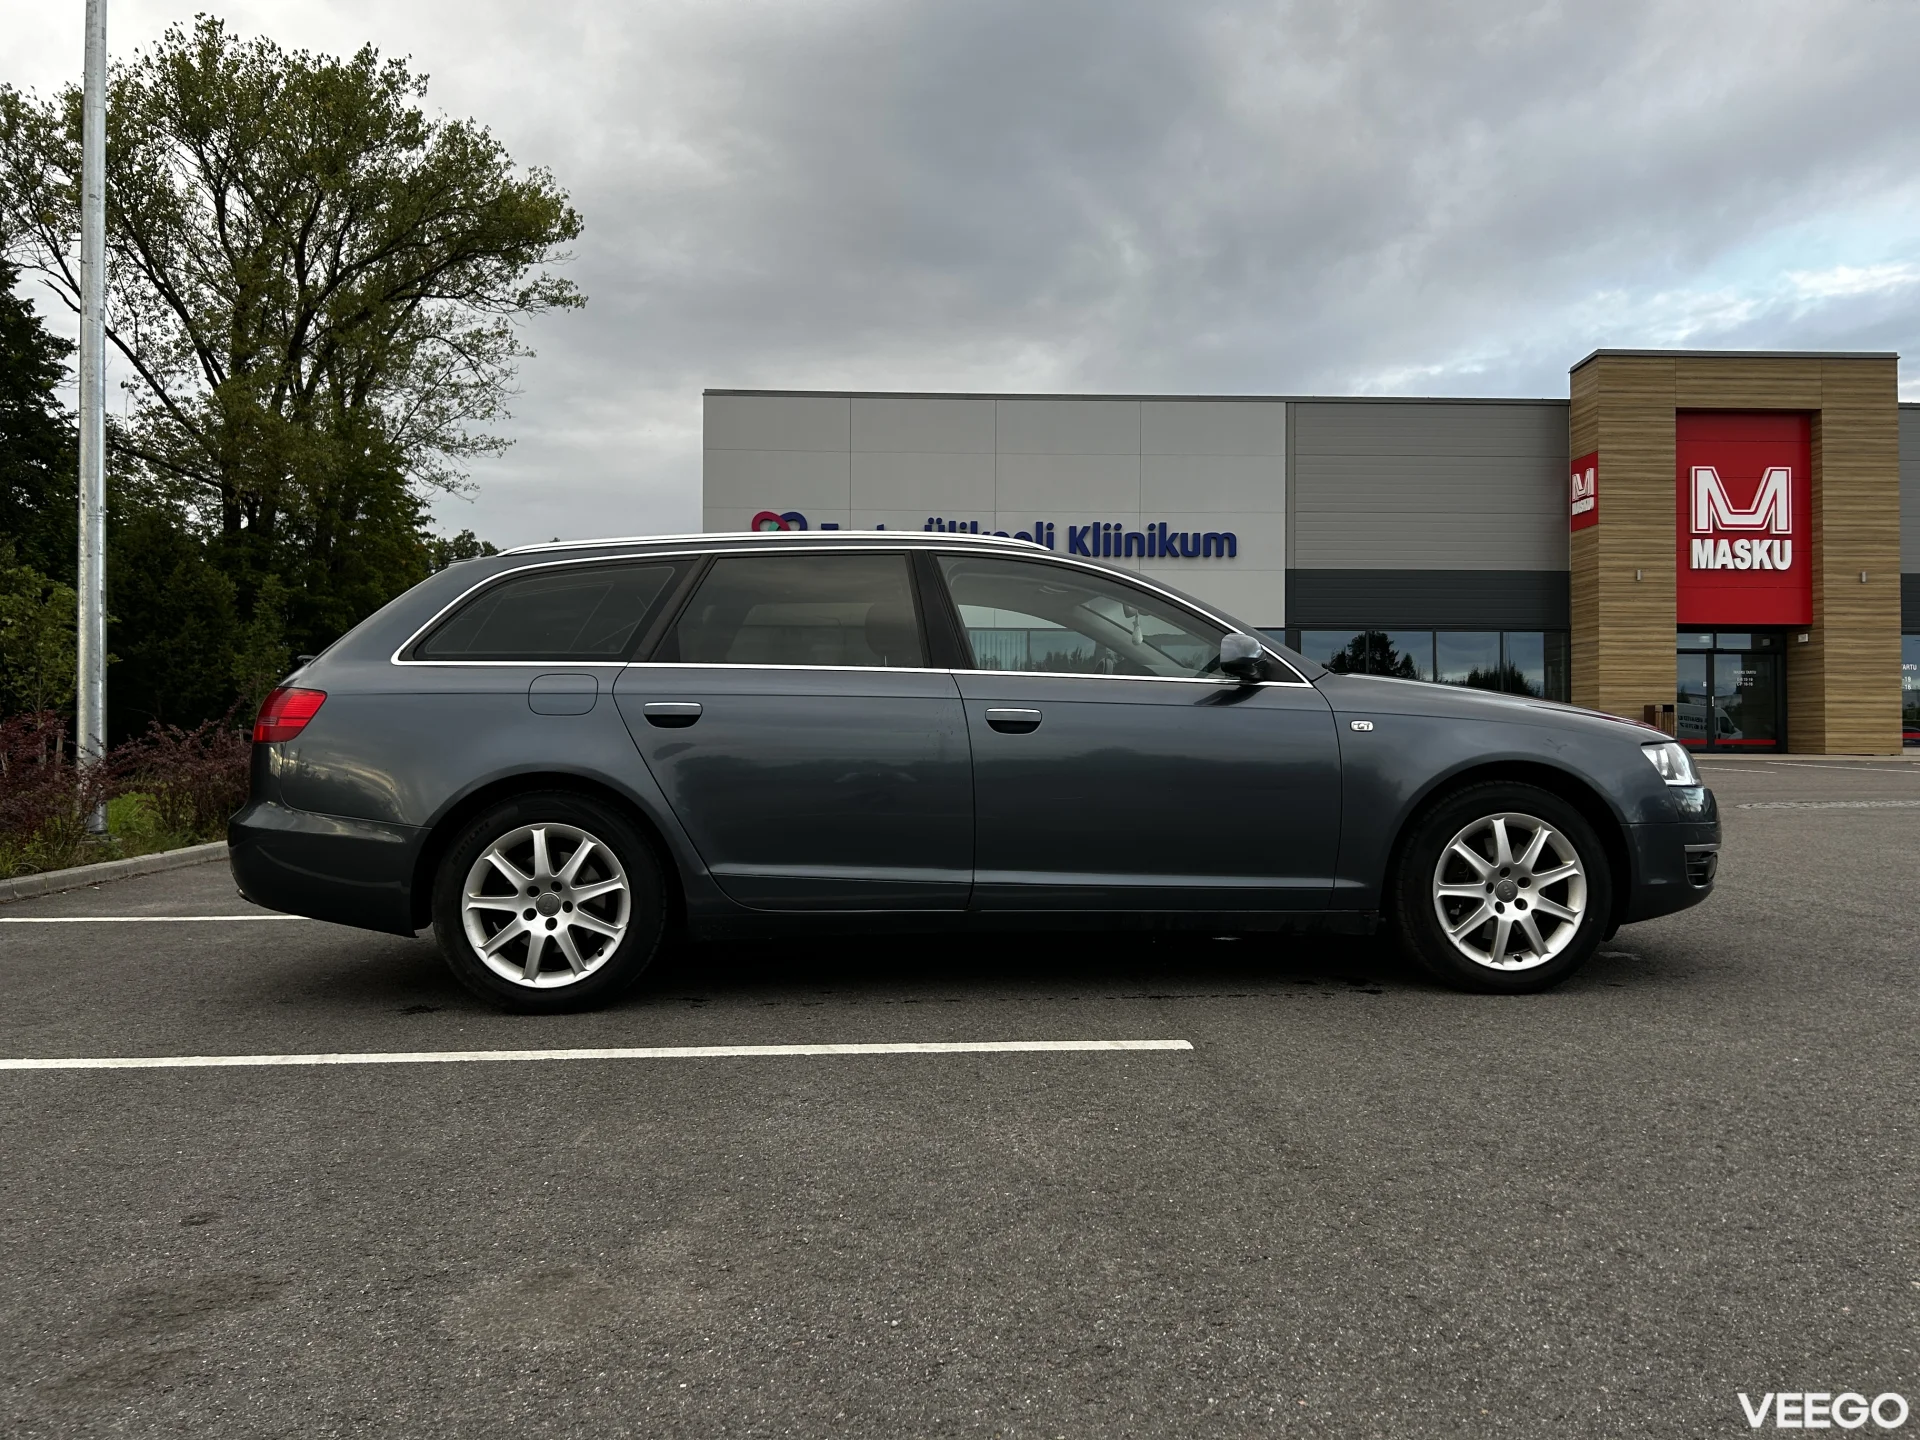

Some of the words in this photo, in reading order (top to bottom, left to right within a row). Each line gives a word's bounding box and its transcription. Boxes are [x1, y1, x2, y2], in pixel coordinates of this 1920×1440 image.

[1068, 521, 1237, 558] Kliinikum
[1690, 538, 1793, 571] MASKU
[1901, 663, 1918, 671] ARTU
